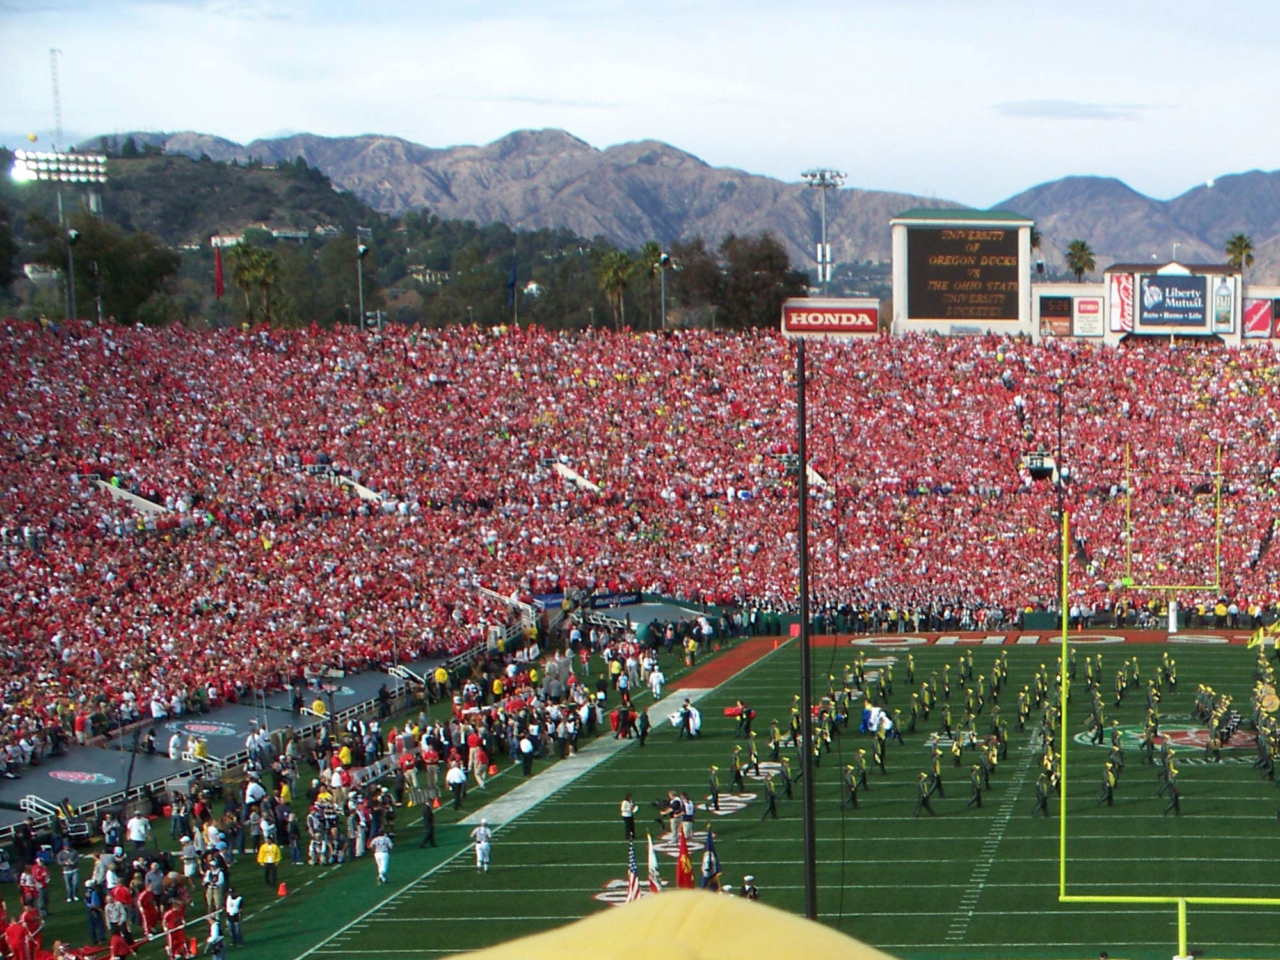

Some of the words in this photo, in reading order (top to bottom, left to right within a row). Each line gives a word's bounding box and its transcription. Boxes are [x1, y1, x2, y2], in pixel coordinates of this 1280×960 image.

[928, 255, 976, 265] OREGON
[980, 255, 1017, 266] DUCKS
[1165, 287, 1202, 299] Liberty
[790, 312, 874, 326] HONDA
[850, 635, 1127, 646] OHIO
